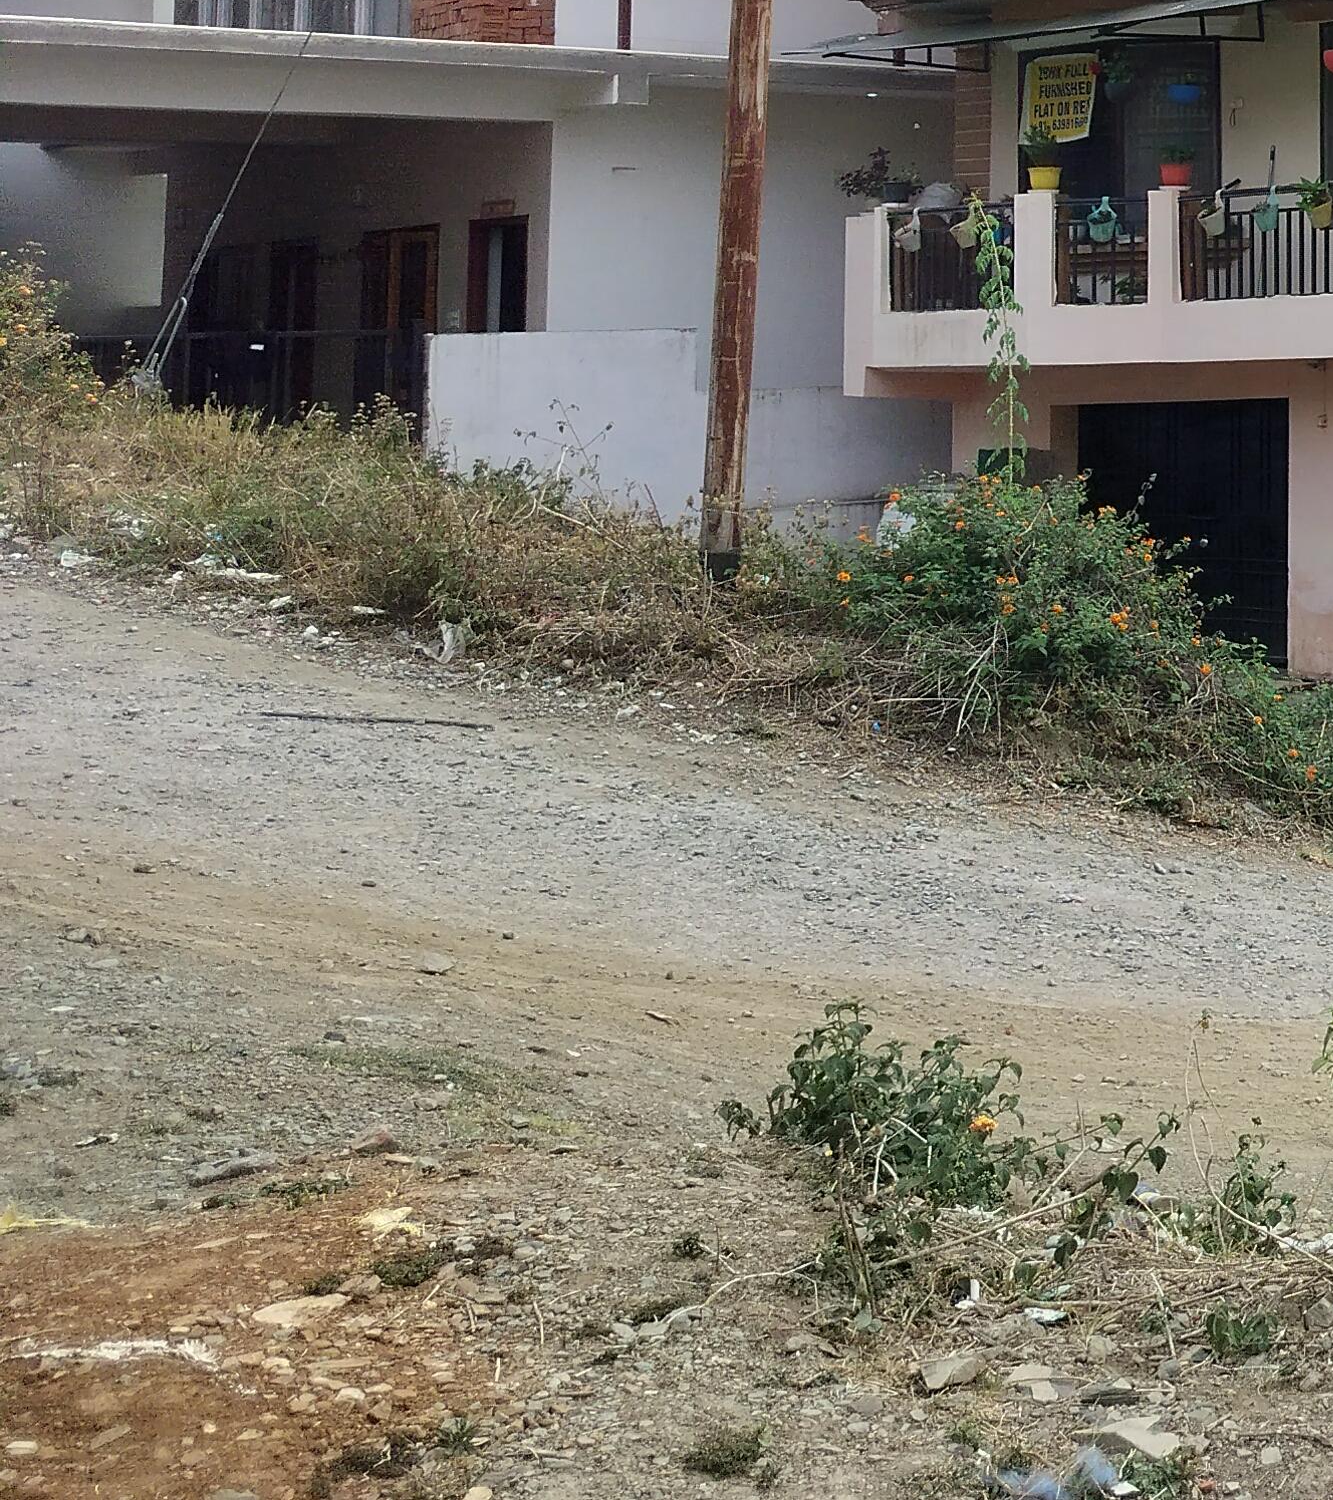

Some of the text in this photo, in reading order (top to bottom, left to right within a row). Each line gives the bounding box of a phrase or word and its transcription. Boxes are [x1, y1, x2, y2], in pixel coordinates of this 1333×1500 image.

[1064, 62, 1089, 78] FULL
[1039, 80, 1092, 99] FURNISHED
[1034, 102, 1054, 118] FLAT
[1057, 101, 1070, 116] ON
